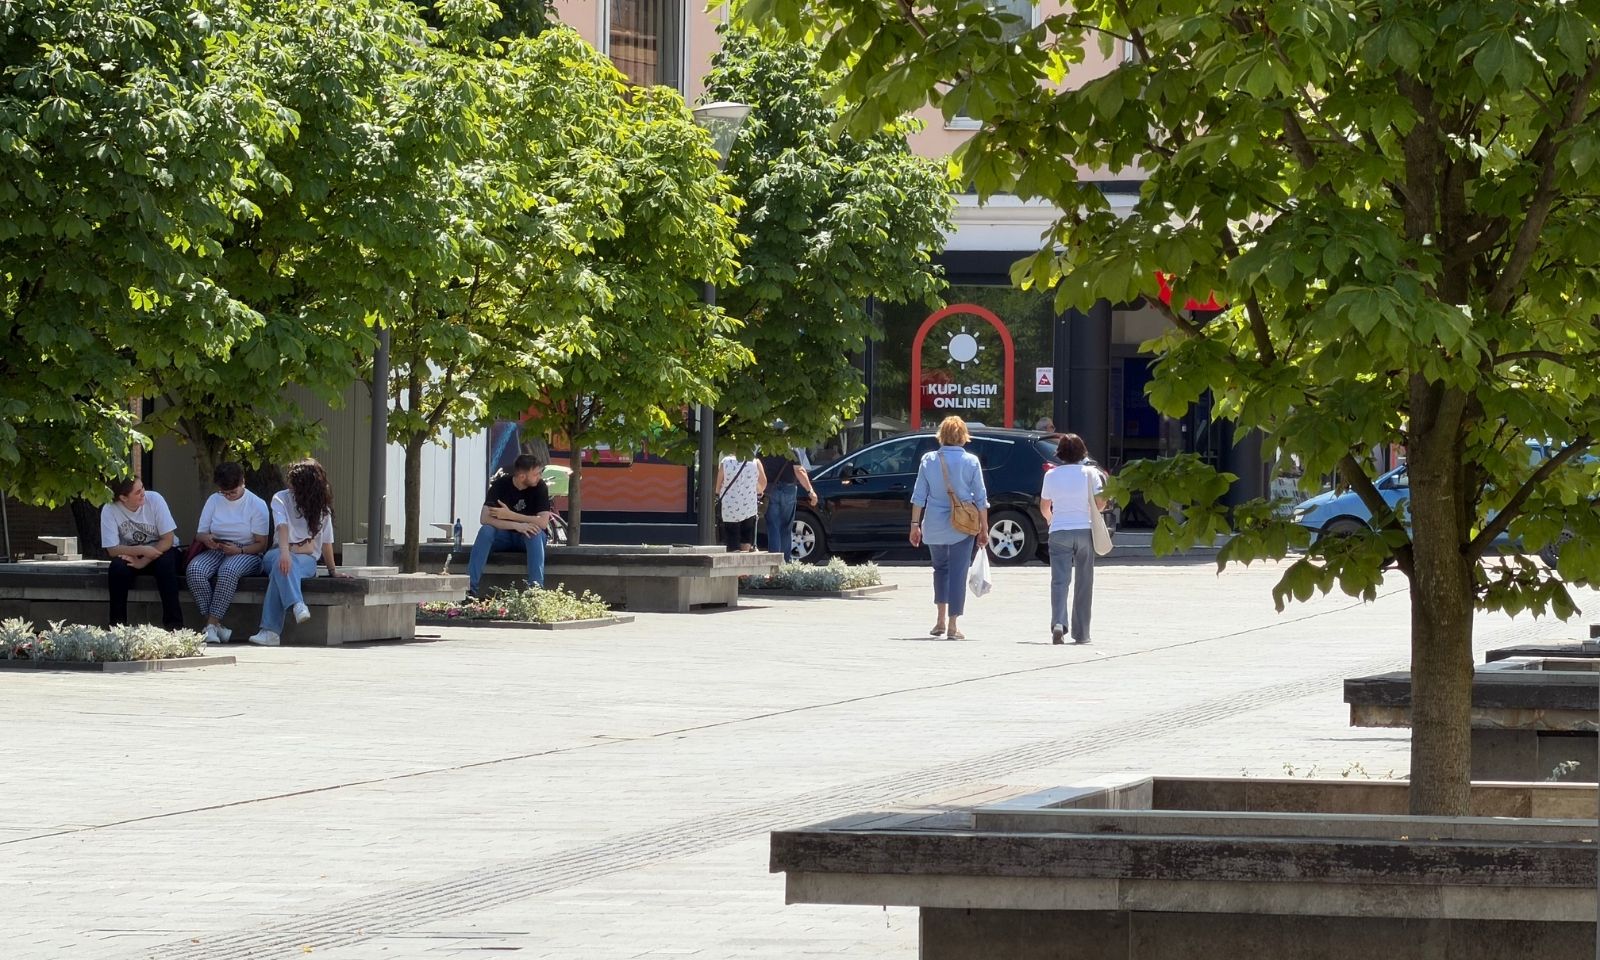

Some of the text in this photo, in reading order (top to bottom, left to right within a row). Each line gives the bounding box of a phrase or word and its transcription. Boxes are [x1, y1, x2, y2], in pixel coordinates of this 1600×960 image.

[928, 383, 962, 395] KUPI
[963, 383, 998, 395] eSIM
[933, 397, 991, 409] ONLINE!
